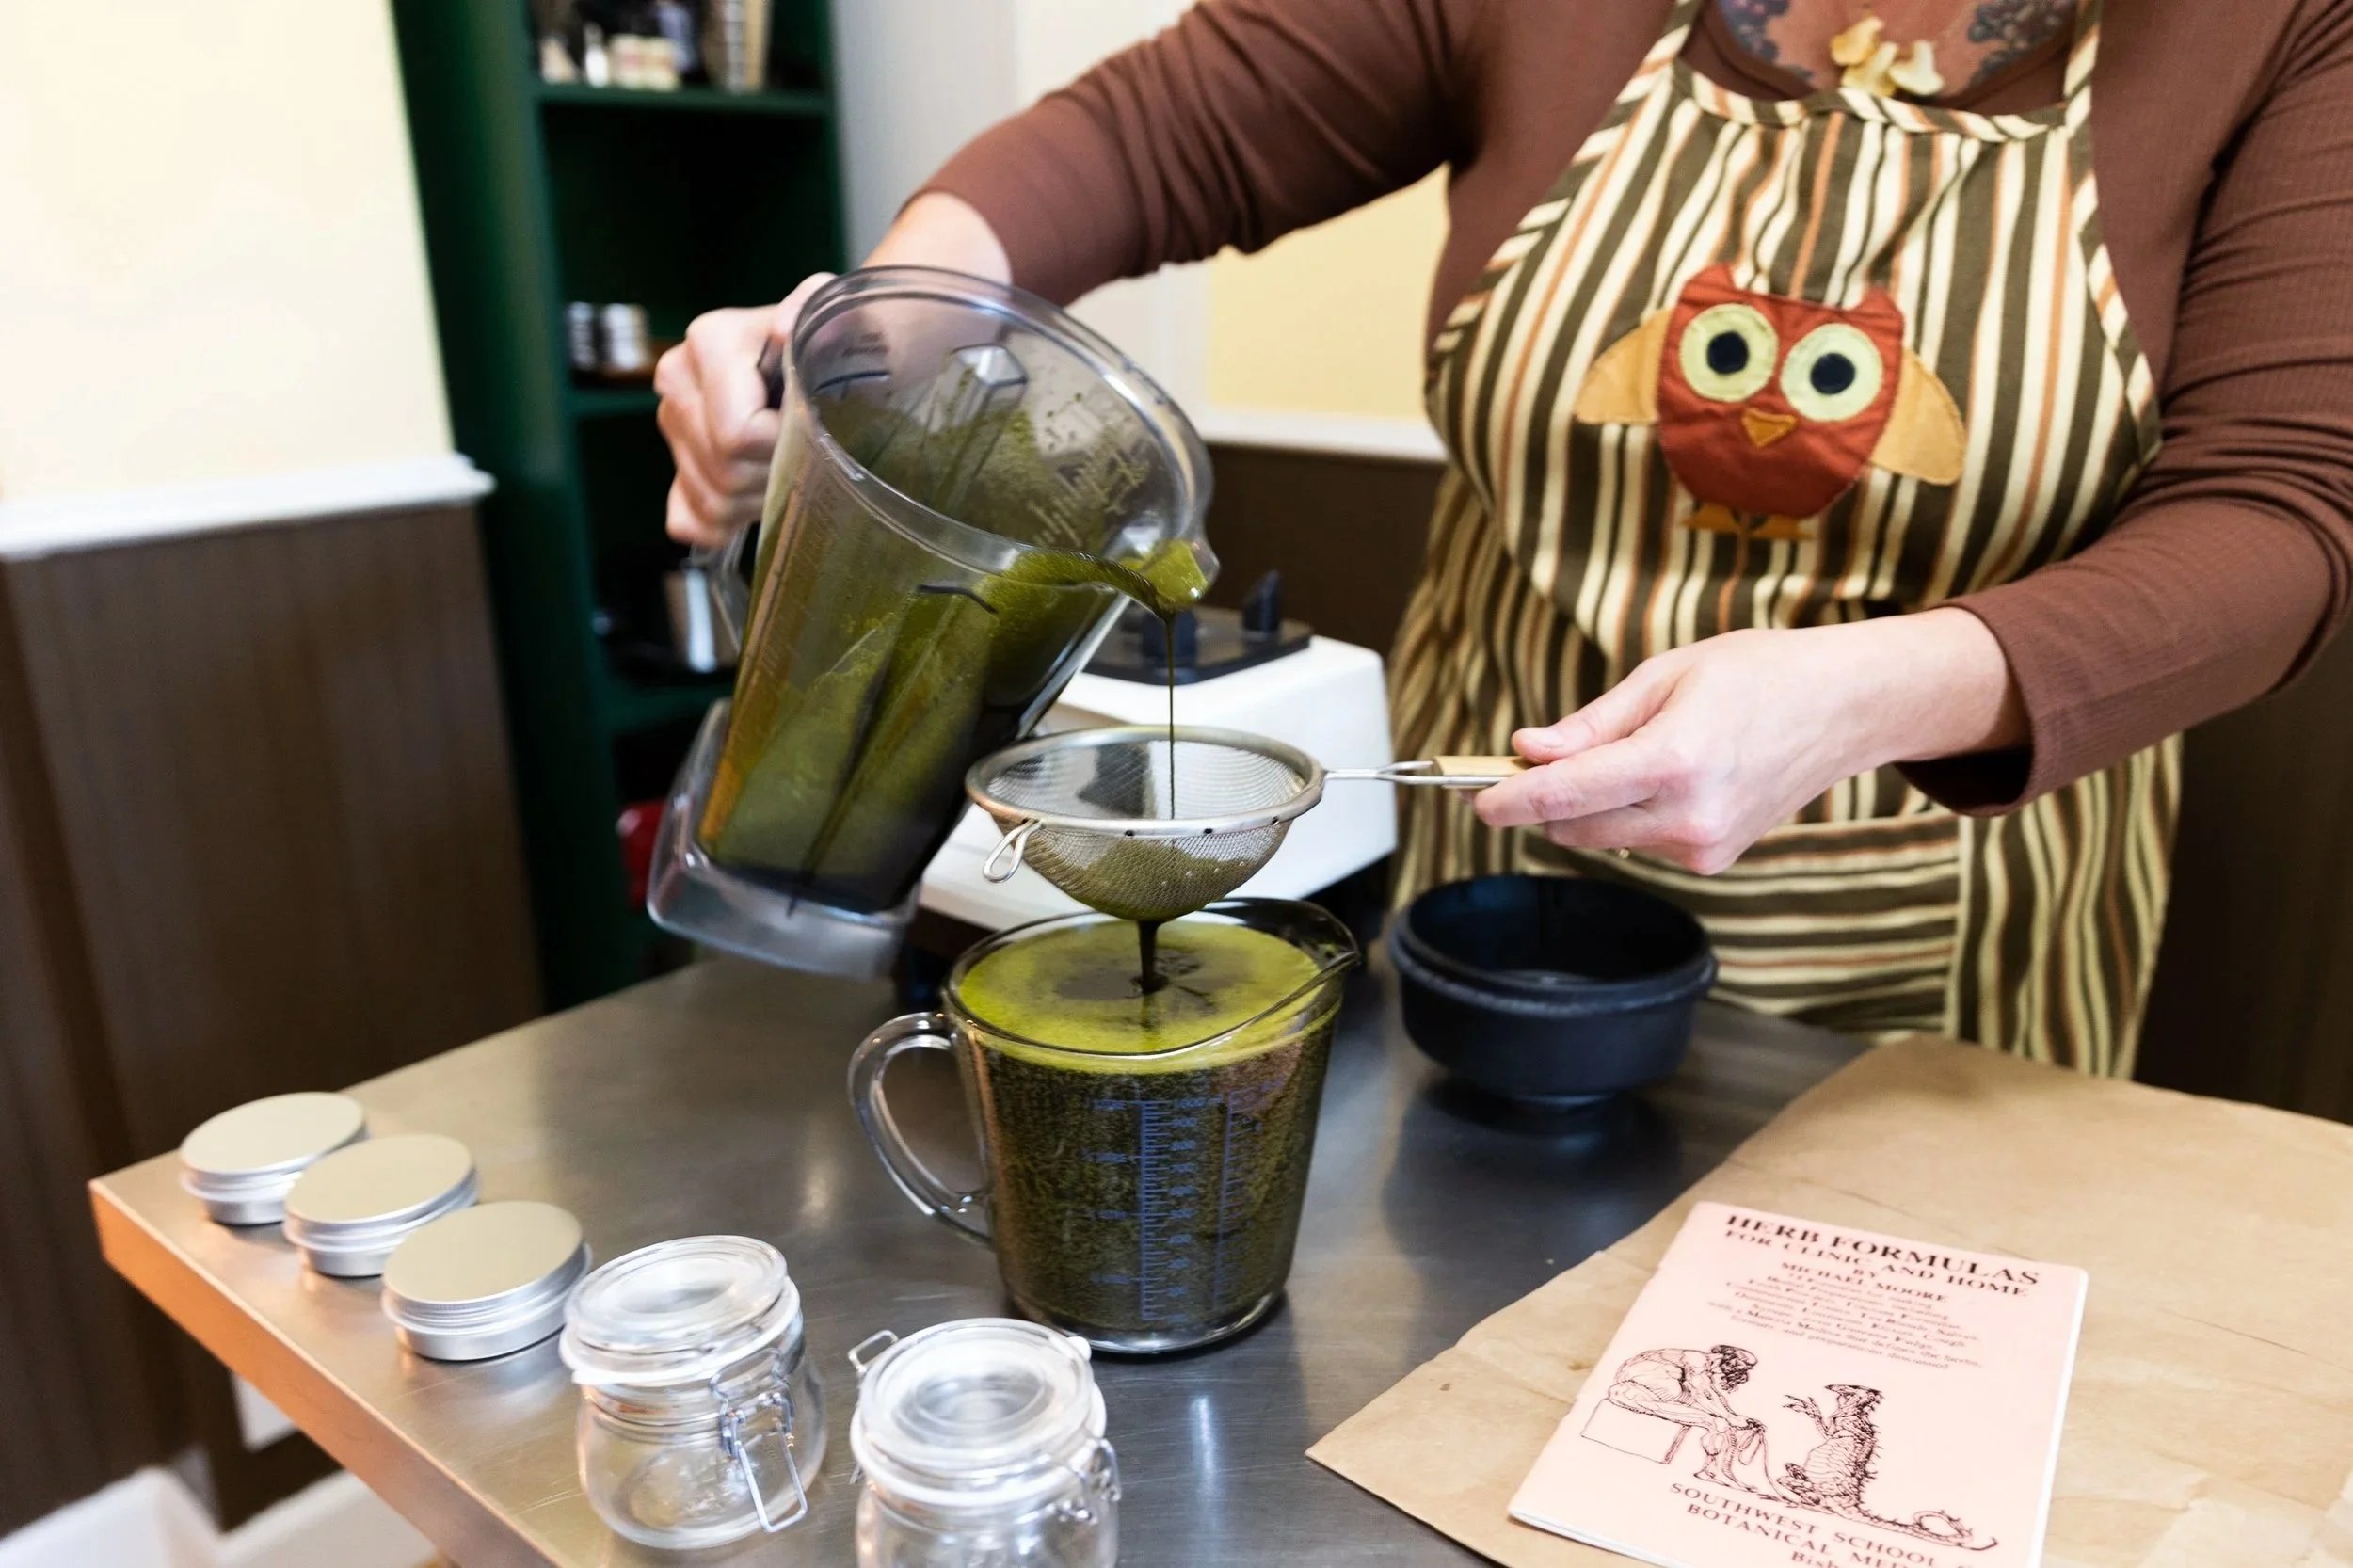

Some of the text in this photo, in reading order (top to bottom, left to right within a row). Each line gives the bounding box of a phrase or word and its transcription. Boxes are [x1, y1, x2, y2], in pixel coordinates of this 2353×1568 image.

[1725, 1229, 2029, 1297] FOR CLINIC AND HOME
[1727, 1215, 2040, 1285] HERB FORMULAS
[1852, 1268, 1877, 1278] BY
[1782, 1261, 1948, 1303] MICHAEL MOORE
[1670, 1482, 1937, 1567] SOUTHWEST SCHOOL
[1687, 1503, 1833, 1555] BOTANICAL
